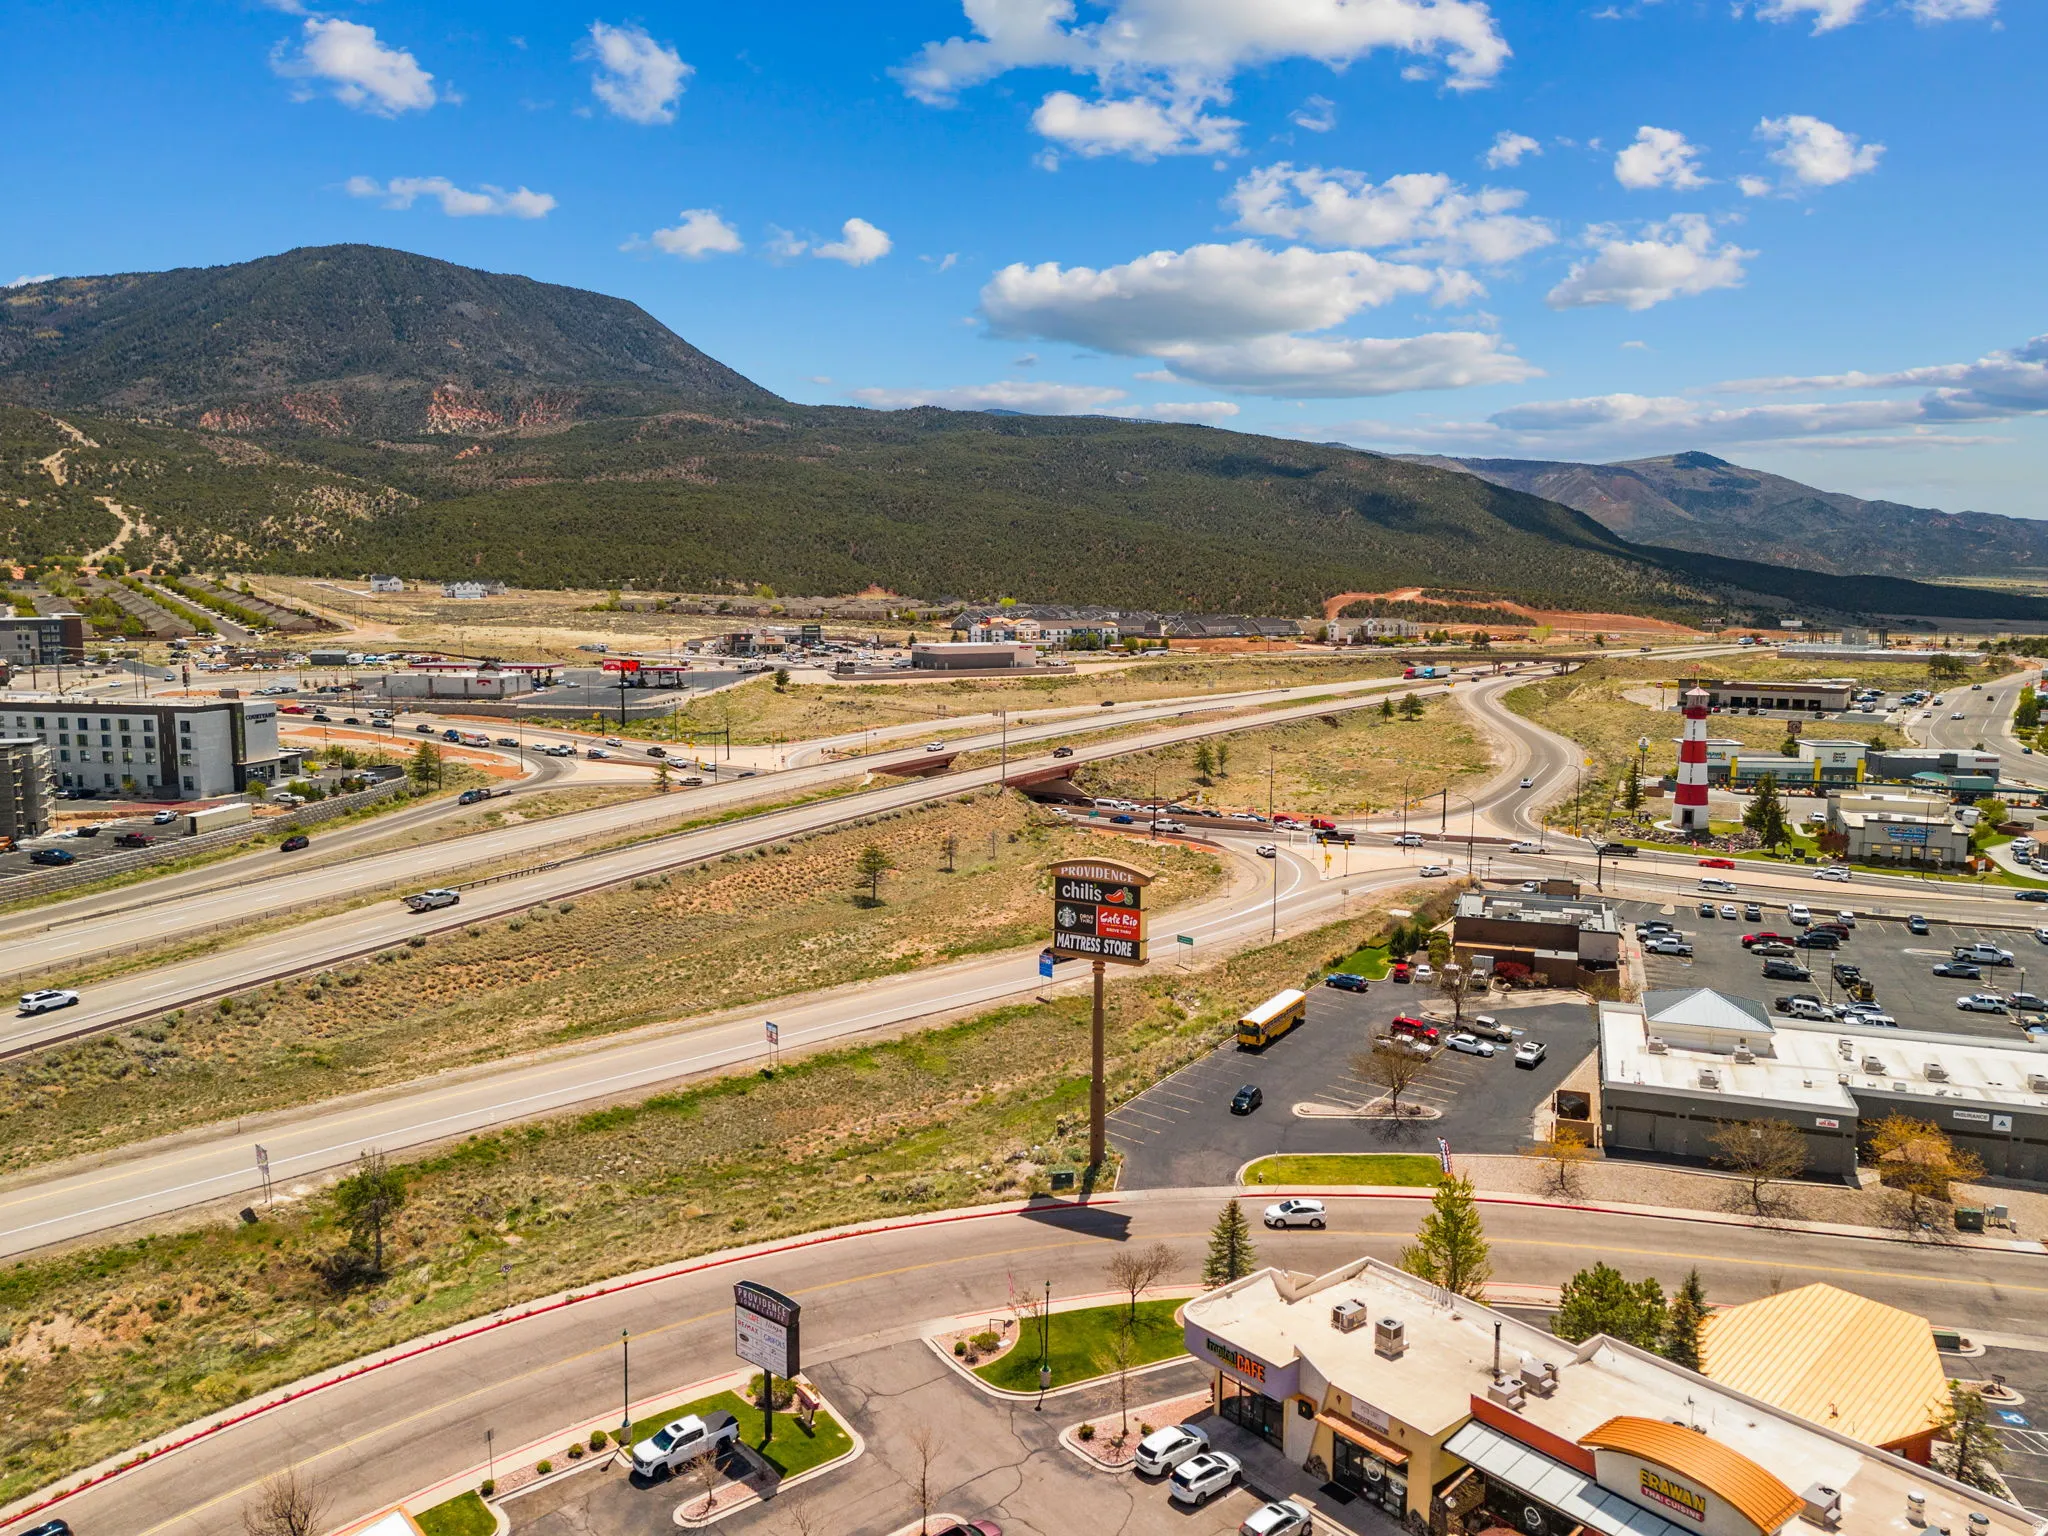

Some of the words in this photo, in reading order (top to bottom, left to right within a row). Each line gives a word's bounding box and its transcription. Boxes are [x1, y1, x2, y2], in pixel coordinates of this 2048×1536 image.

[1061, 866, 1134, 883] PROVIDENCE
[1062, 881, 1102, 901] chili's
[1122, 915, 1138, 927] Rio
[1056, 932, 1101, 952] MATTRESS
[1103, 939, 1132, 957] STORE
[1954, 1112, 1988, 1120] INSURANCE
[737, 1287, 786, 1317] PROVIDENCE
[737, 1319, 759, 1334] RE/MAX
[1236, 1353, 1266, 1383] CAFE
[1639, 1468, 1706, 1513] ERAWAN
[1643, 1486, 1664, 1502] THAI
[1665, 1497, 1702, 1519] CUISINE
